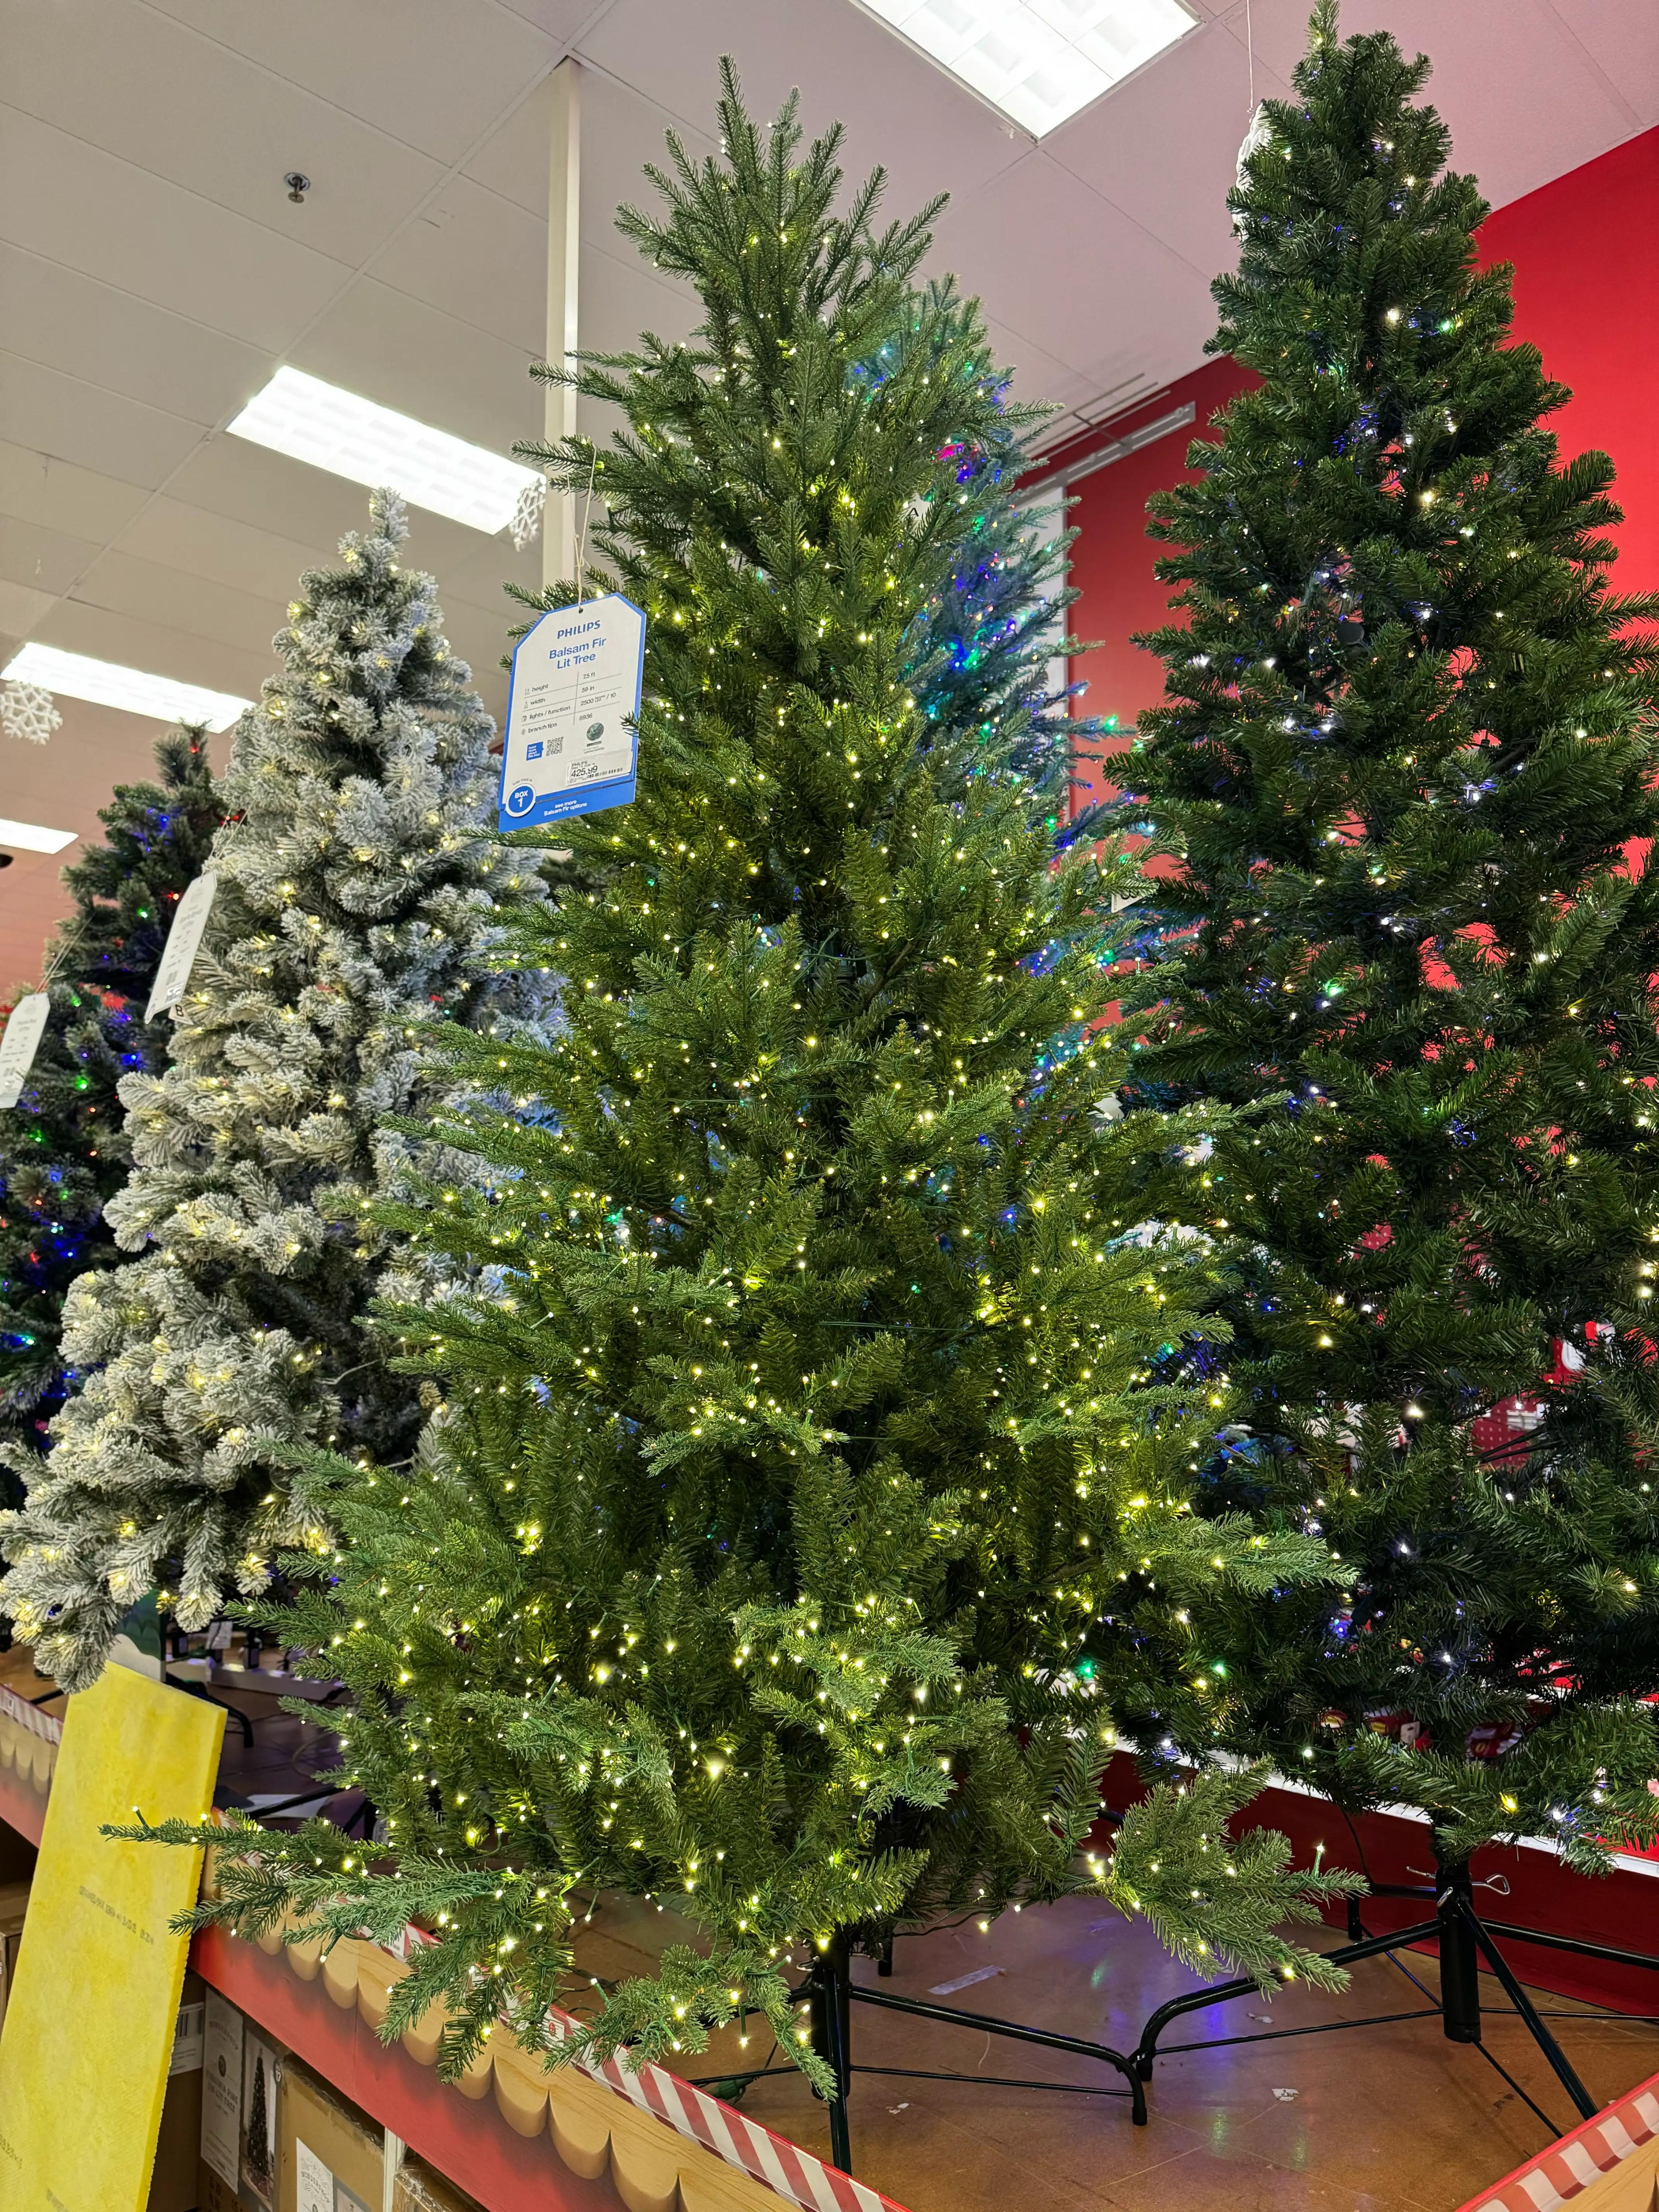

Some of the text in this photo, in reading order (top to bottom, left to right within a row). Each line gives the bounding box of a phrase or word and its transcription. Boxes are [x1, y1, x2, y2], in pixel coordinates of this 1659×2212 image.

[907, 508, 919, 517] A
[557, 620, 601, 639] PHILIPS
[549, 638, 607, 659] Balsam Fir
[557, 654, 596, 669] Lit Tree
[532, 683, 549, 692] height
[529, 712, 543, 720] lights
[548, 706, 570, 715] function
[528, 725, 547, 733] branch
[515, 790, 528, 798] BOX
[518, 797, 523, 807] 1
[544, 808, 562, 816] Balsam
[570, 802, 588, 810] options
[175, 1004, 184, 1017] B
